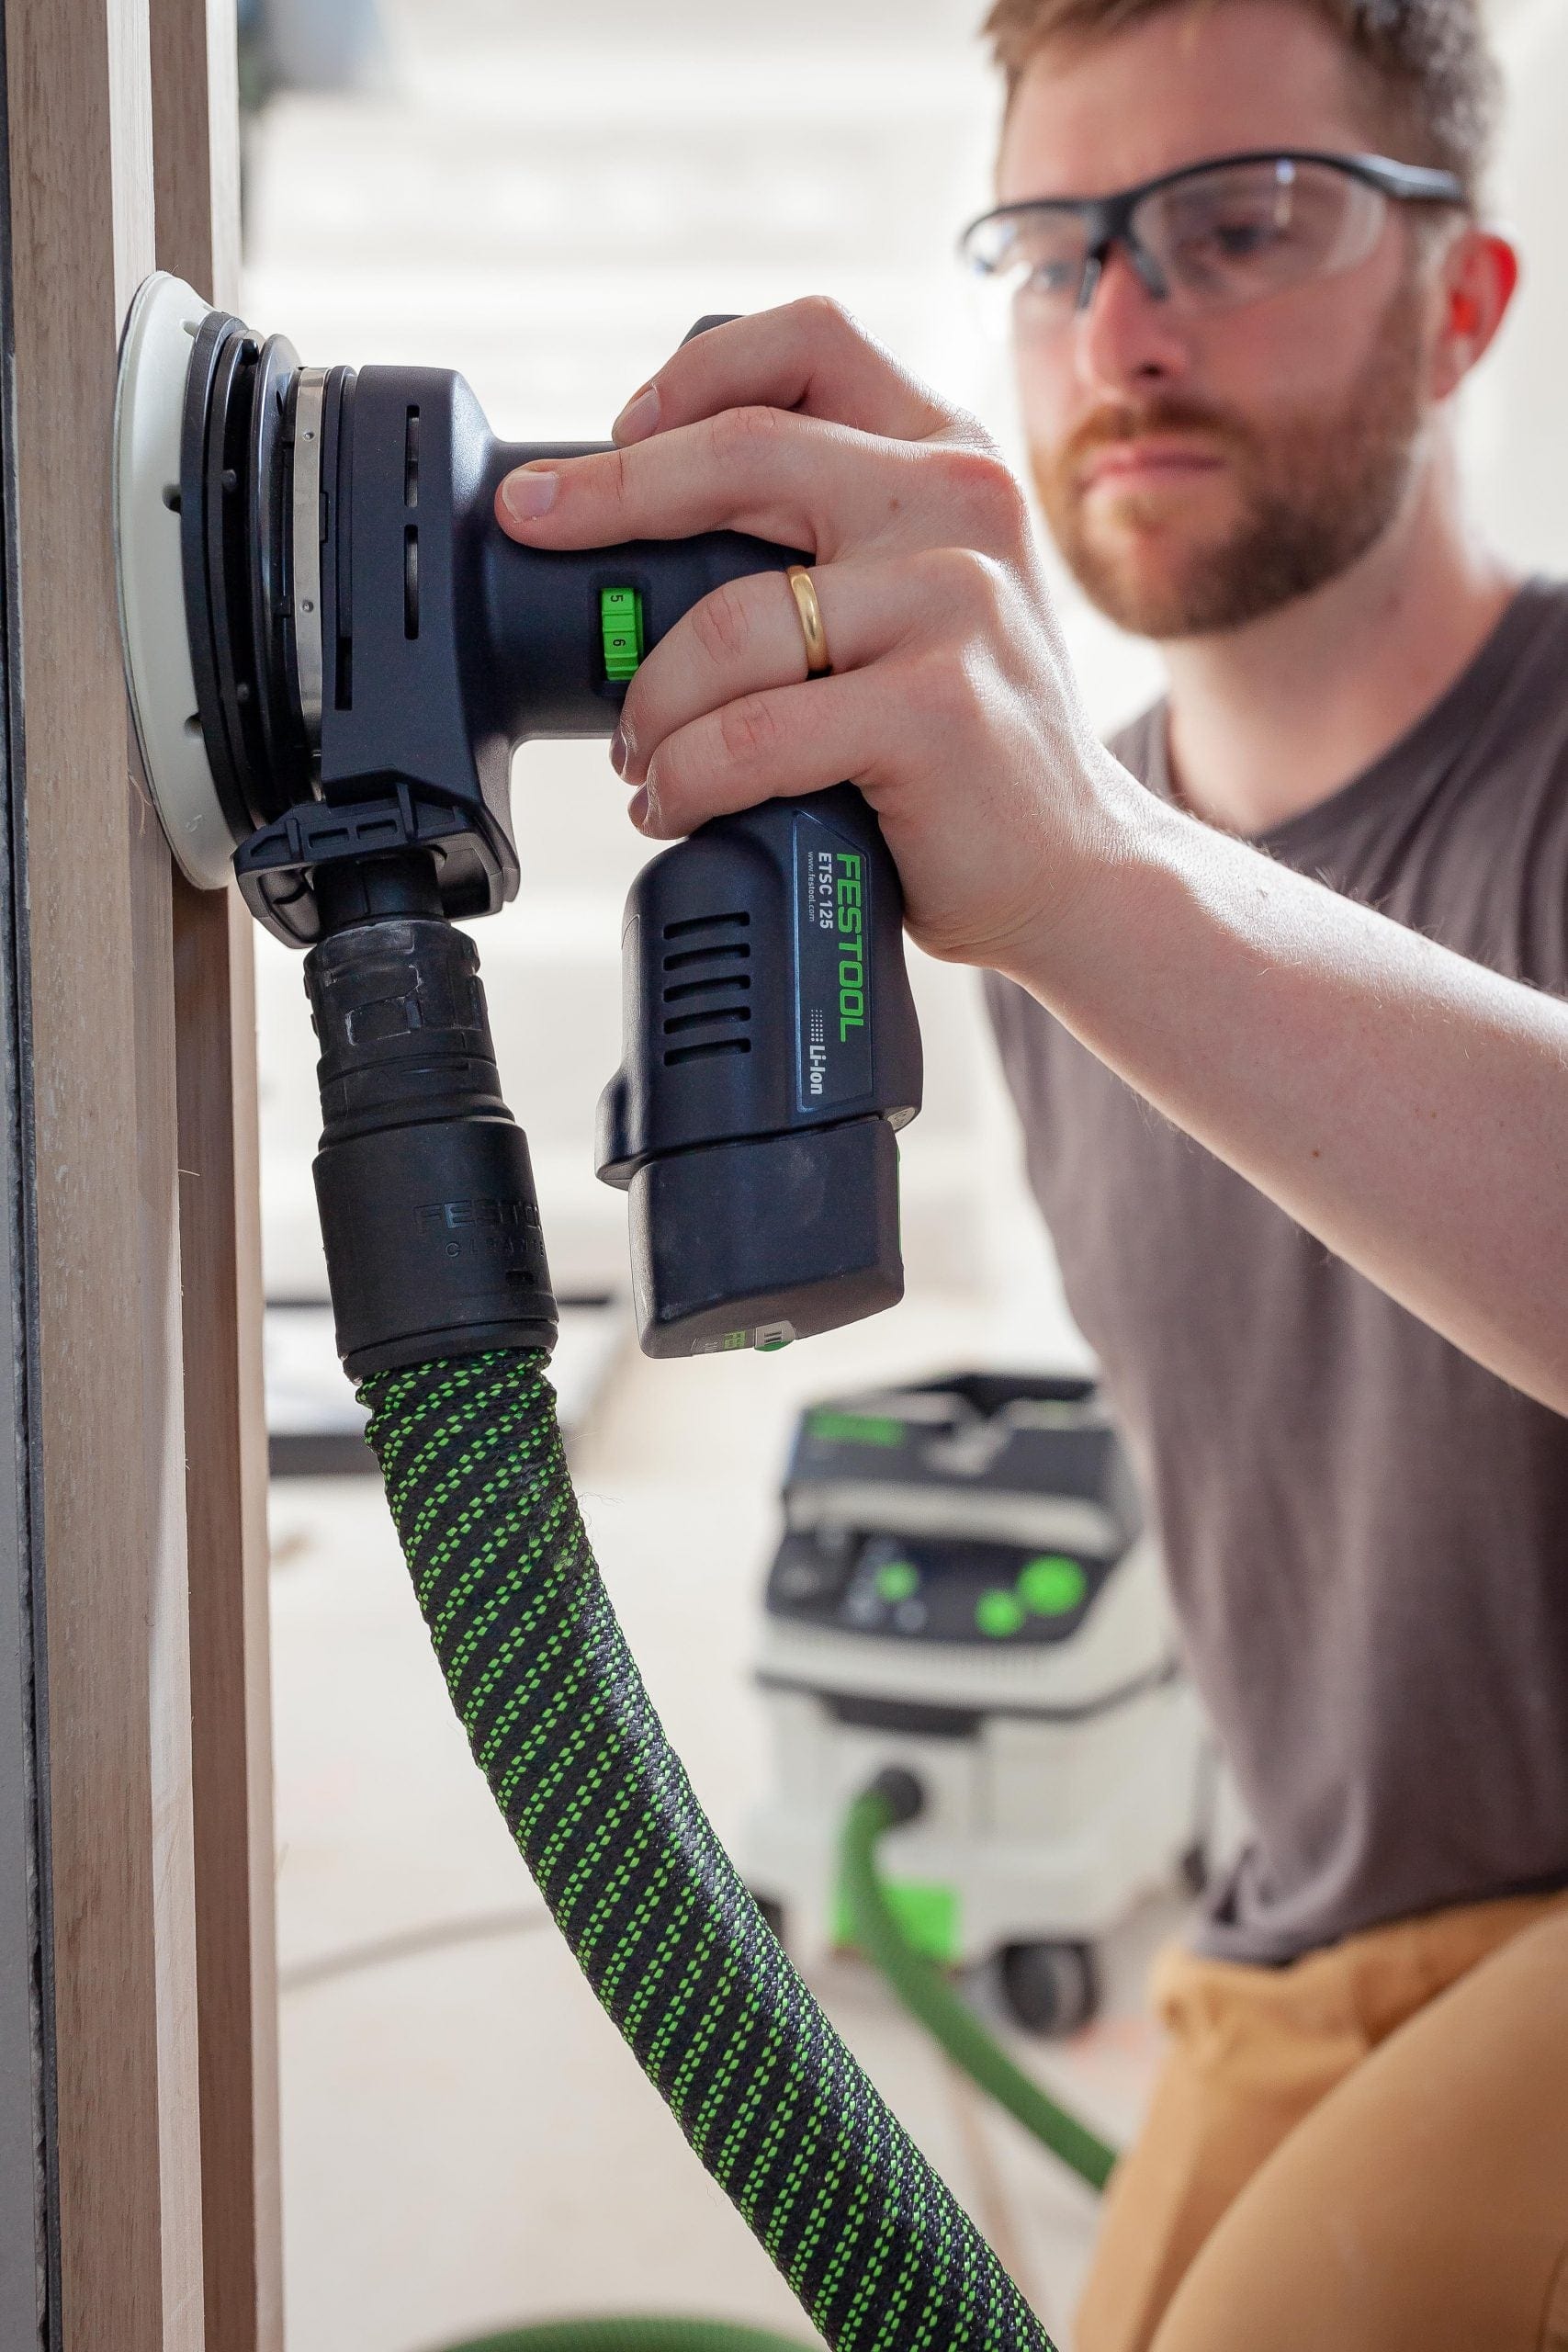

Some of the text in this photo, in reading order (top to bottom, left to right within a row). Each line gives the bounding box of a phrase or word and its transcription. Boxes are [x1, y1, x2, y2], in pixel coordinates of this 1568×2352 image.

[611, 594, 626, 647] 5 6
[807, 851, 816, 922] www.festool.com
[818, 853, 833, 929] ETSC 125
[837, 854, 863, 1043] FESTOOL
[810, 1046, 827, 1095] Li-Ion
[414, 1200, 542, 1231] FESTO
